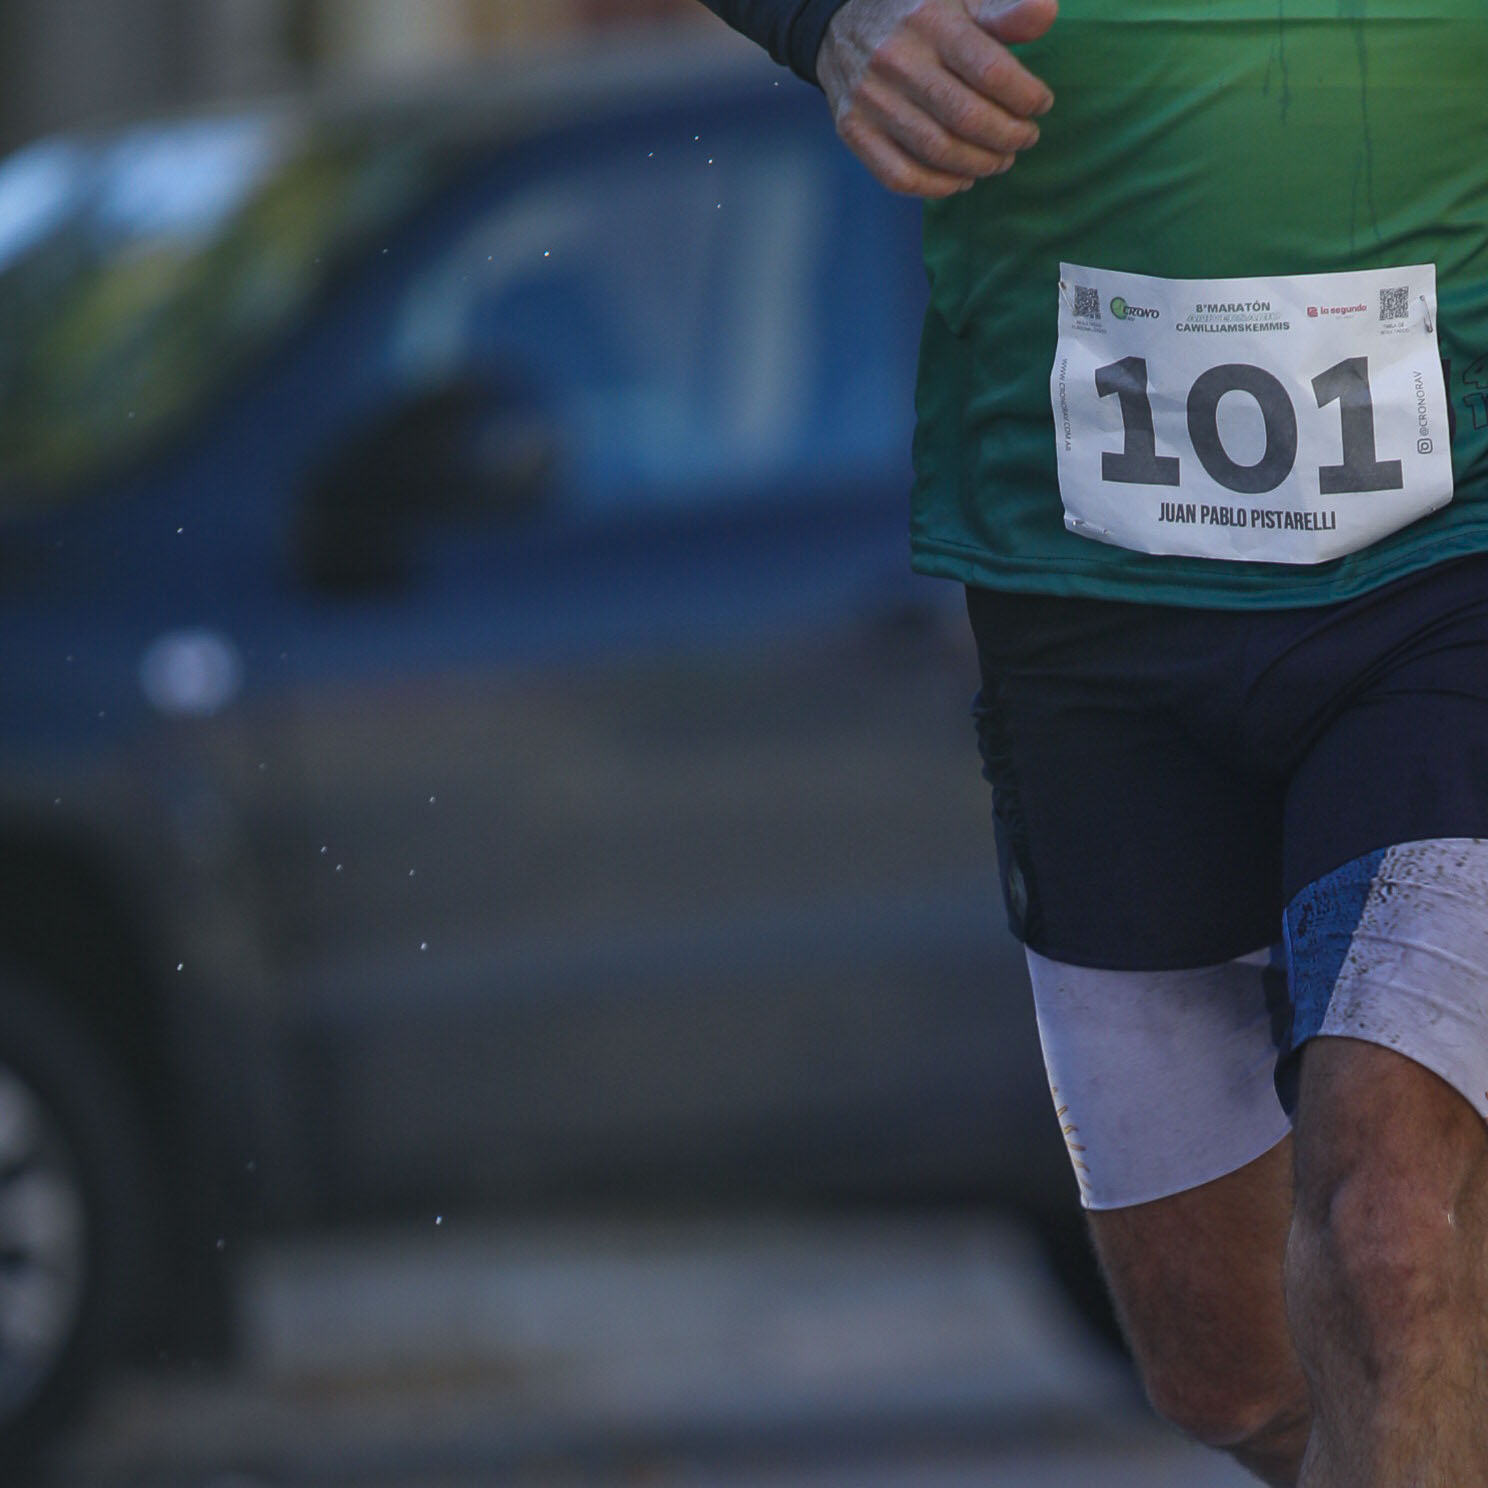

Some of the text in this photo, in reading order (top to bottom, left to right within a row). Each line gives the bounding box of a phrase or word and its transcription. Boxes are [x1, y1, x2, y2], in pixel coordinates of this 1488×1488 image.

[1176, 322, 1290, 333] CAWILLIAMSKEMMIS
[1095, 356, 1403, 495] 101
[1413, 371, 1430, 436] @CRONORAV
[1158, 502, 1336, 531] JUAN PABLO PISTARELLI
